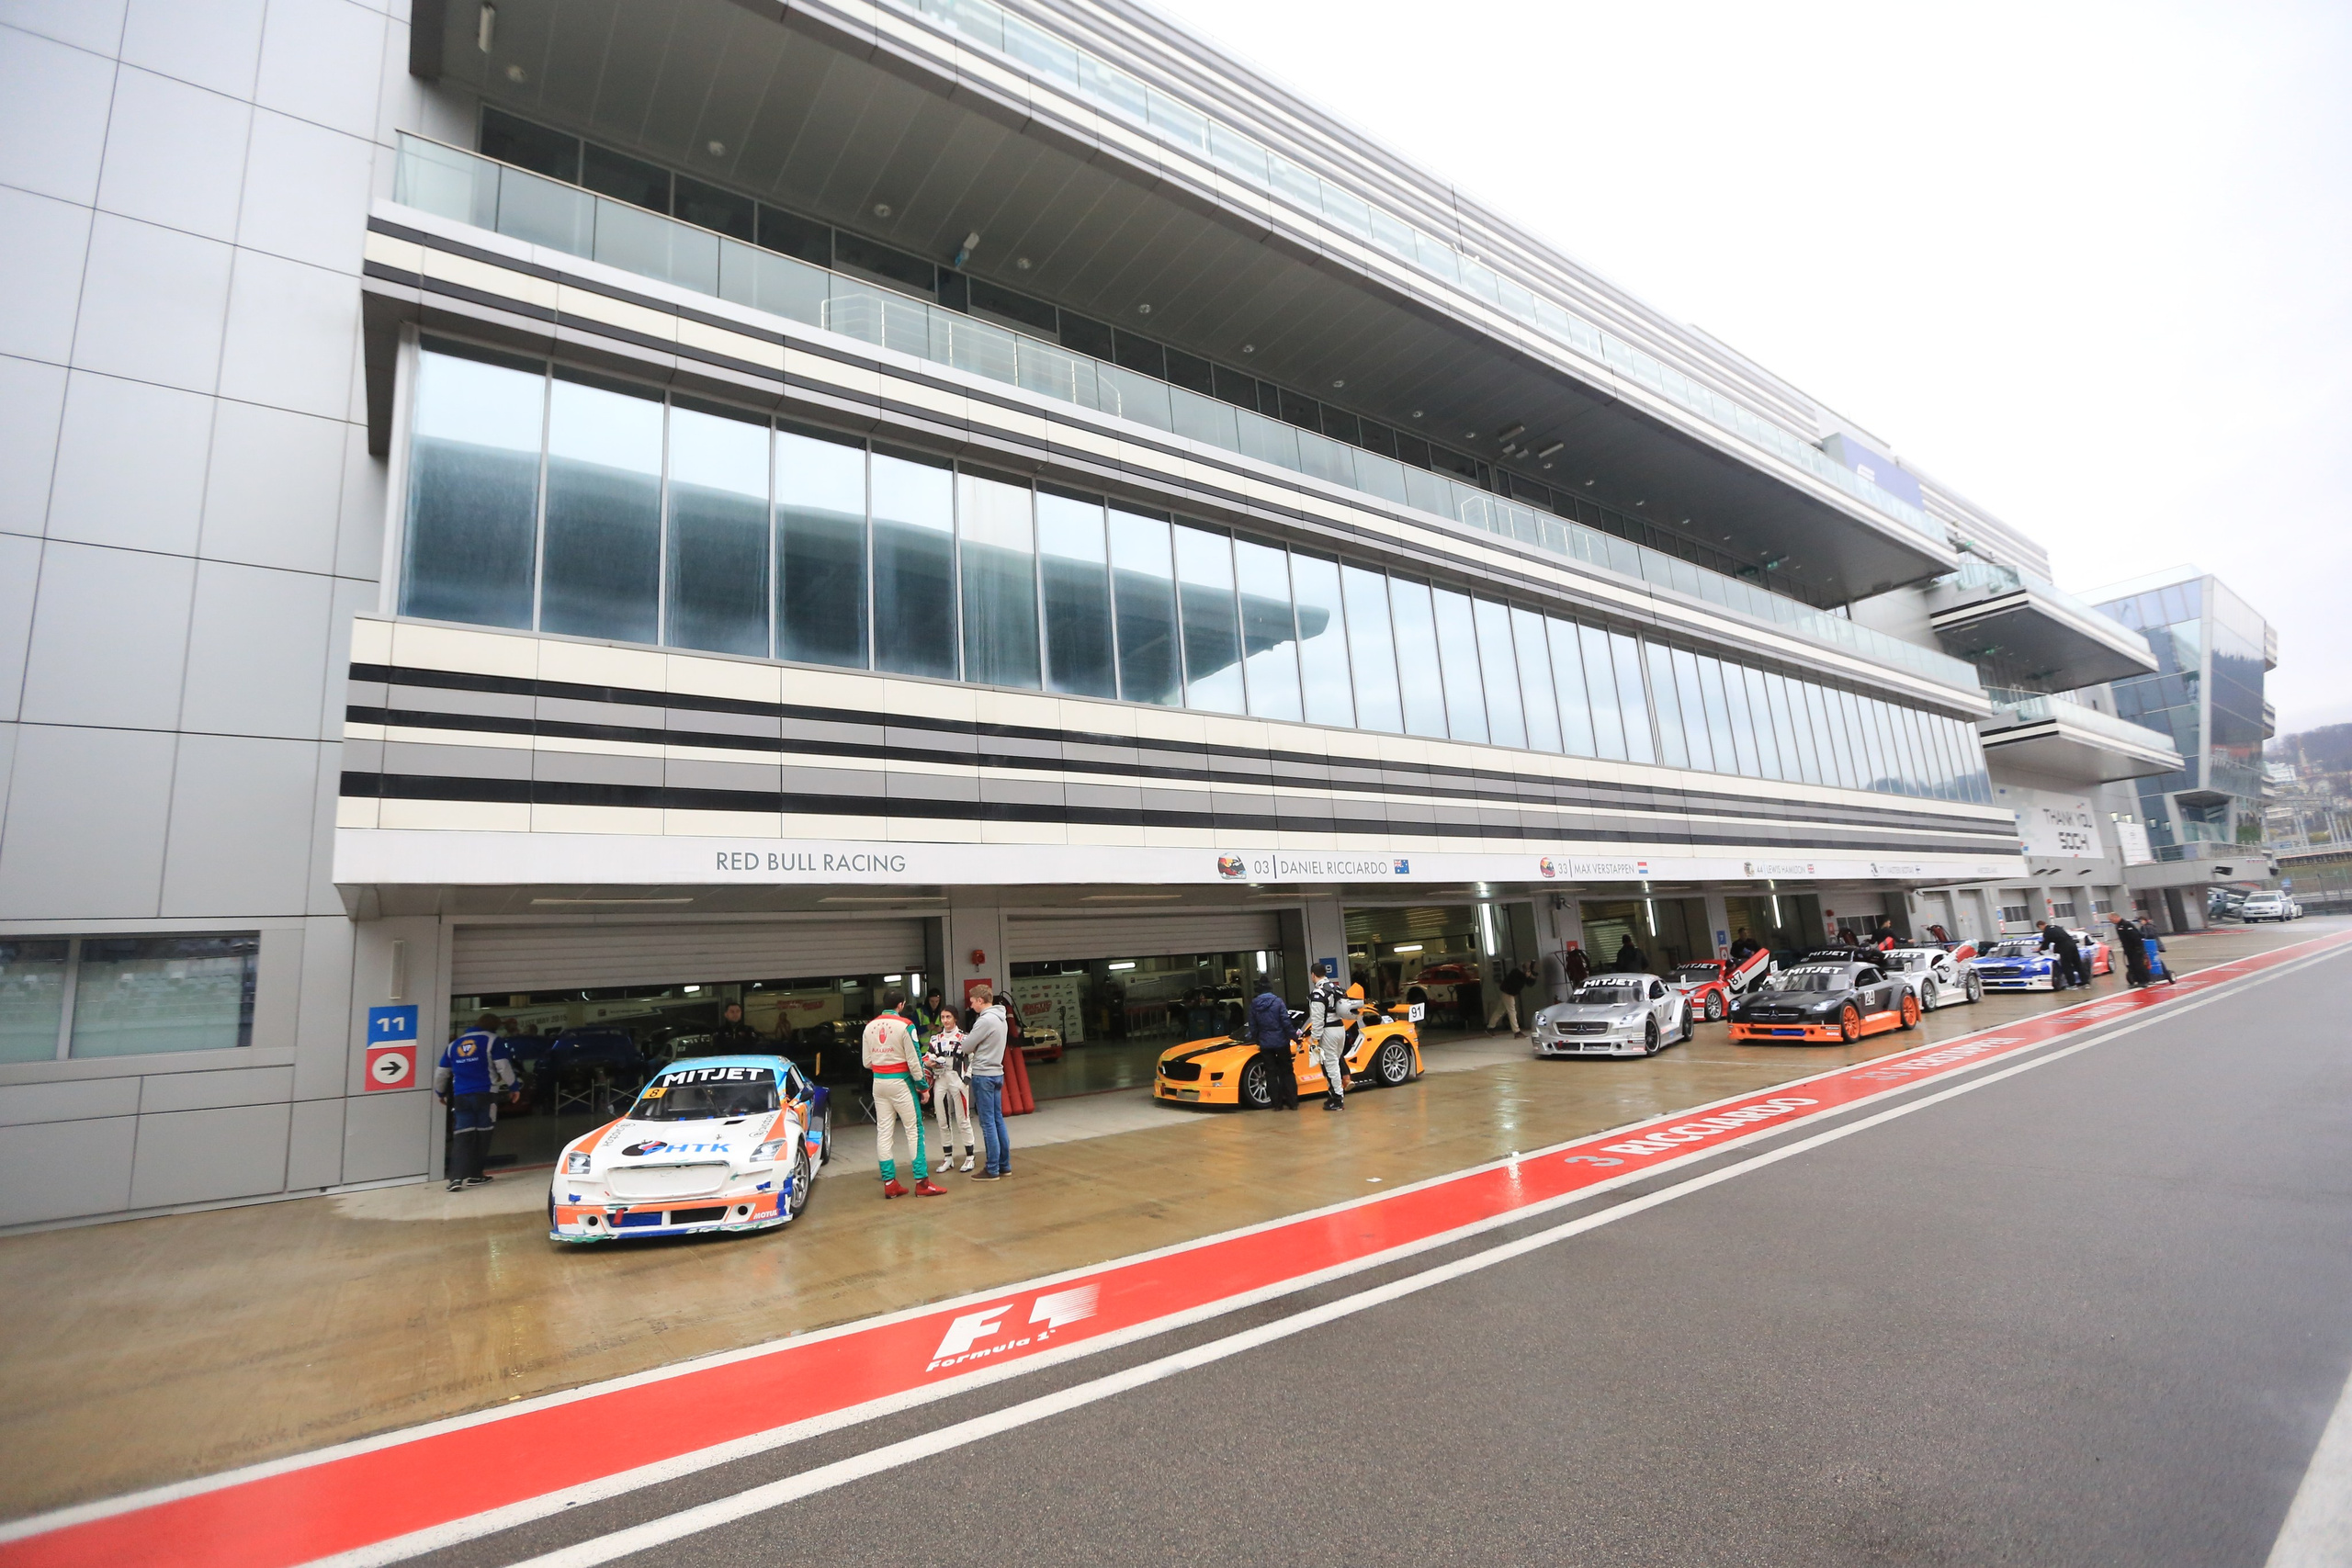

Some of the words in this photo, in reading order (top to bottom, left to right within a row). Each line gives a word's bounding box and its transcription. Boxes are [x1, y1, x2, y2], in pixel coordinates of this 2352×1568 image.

[2043, 808, 2073, 826] THANK
[716, 852, 760, 871] RED
[767, 852, 817, 872] BULL
[823, 853, 907, 873] RACING
[1254, 860, 1270, 874] 03
[1281, 861, 1324, 874] DANIEL
[1327, 862, 1387, 874] RICCIARDO
[1558, 863, 1568, 874] 33
[1574, 863, 1590, 874] MAX
[1591, 863, 1634, 874] VERSTAPPEN
[1767, 865, 1781, 874] LEWIS
[1325, 964, 1332, 974] 9
[1787, 966, 1843, 976] MITJET
[1583, 977, 1637, 988] MITJET
[1730, 971, 1742, 985] 87
[1865, 991, 1874, 1004] 24
[1411, 1006, 1421, 1019] 91
[377, 1016, 405, 1032] 11
[462, 1043, 472, 1052] VP
[662, 1067, 764, 1088] MITJET
[649, 1089, 660, 1098] 8
[1565, 1155, 1624, 1168] 3
[1600, 1097, 1820, 1156] RICCIARDO
[753, 1209, 778, 1221] MOTUL
[933, 1281, 1101, 1360] F1
[925, 1337, 1031, 1372] Formula
